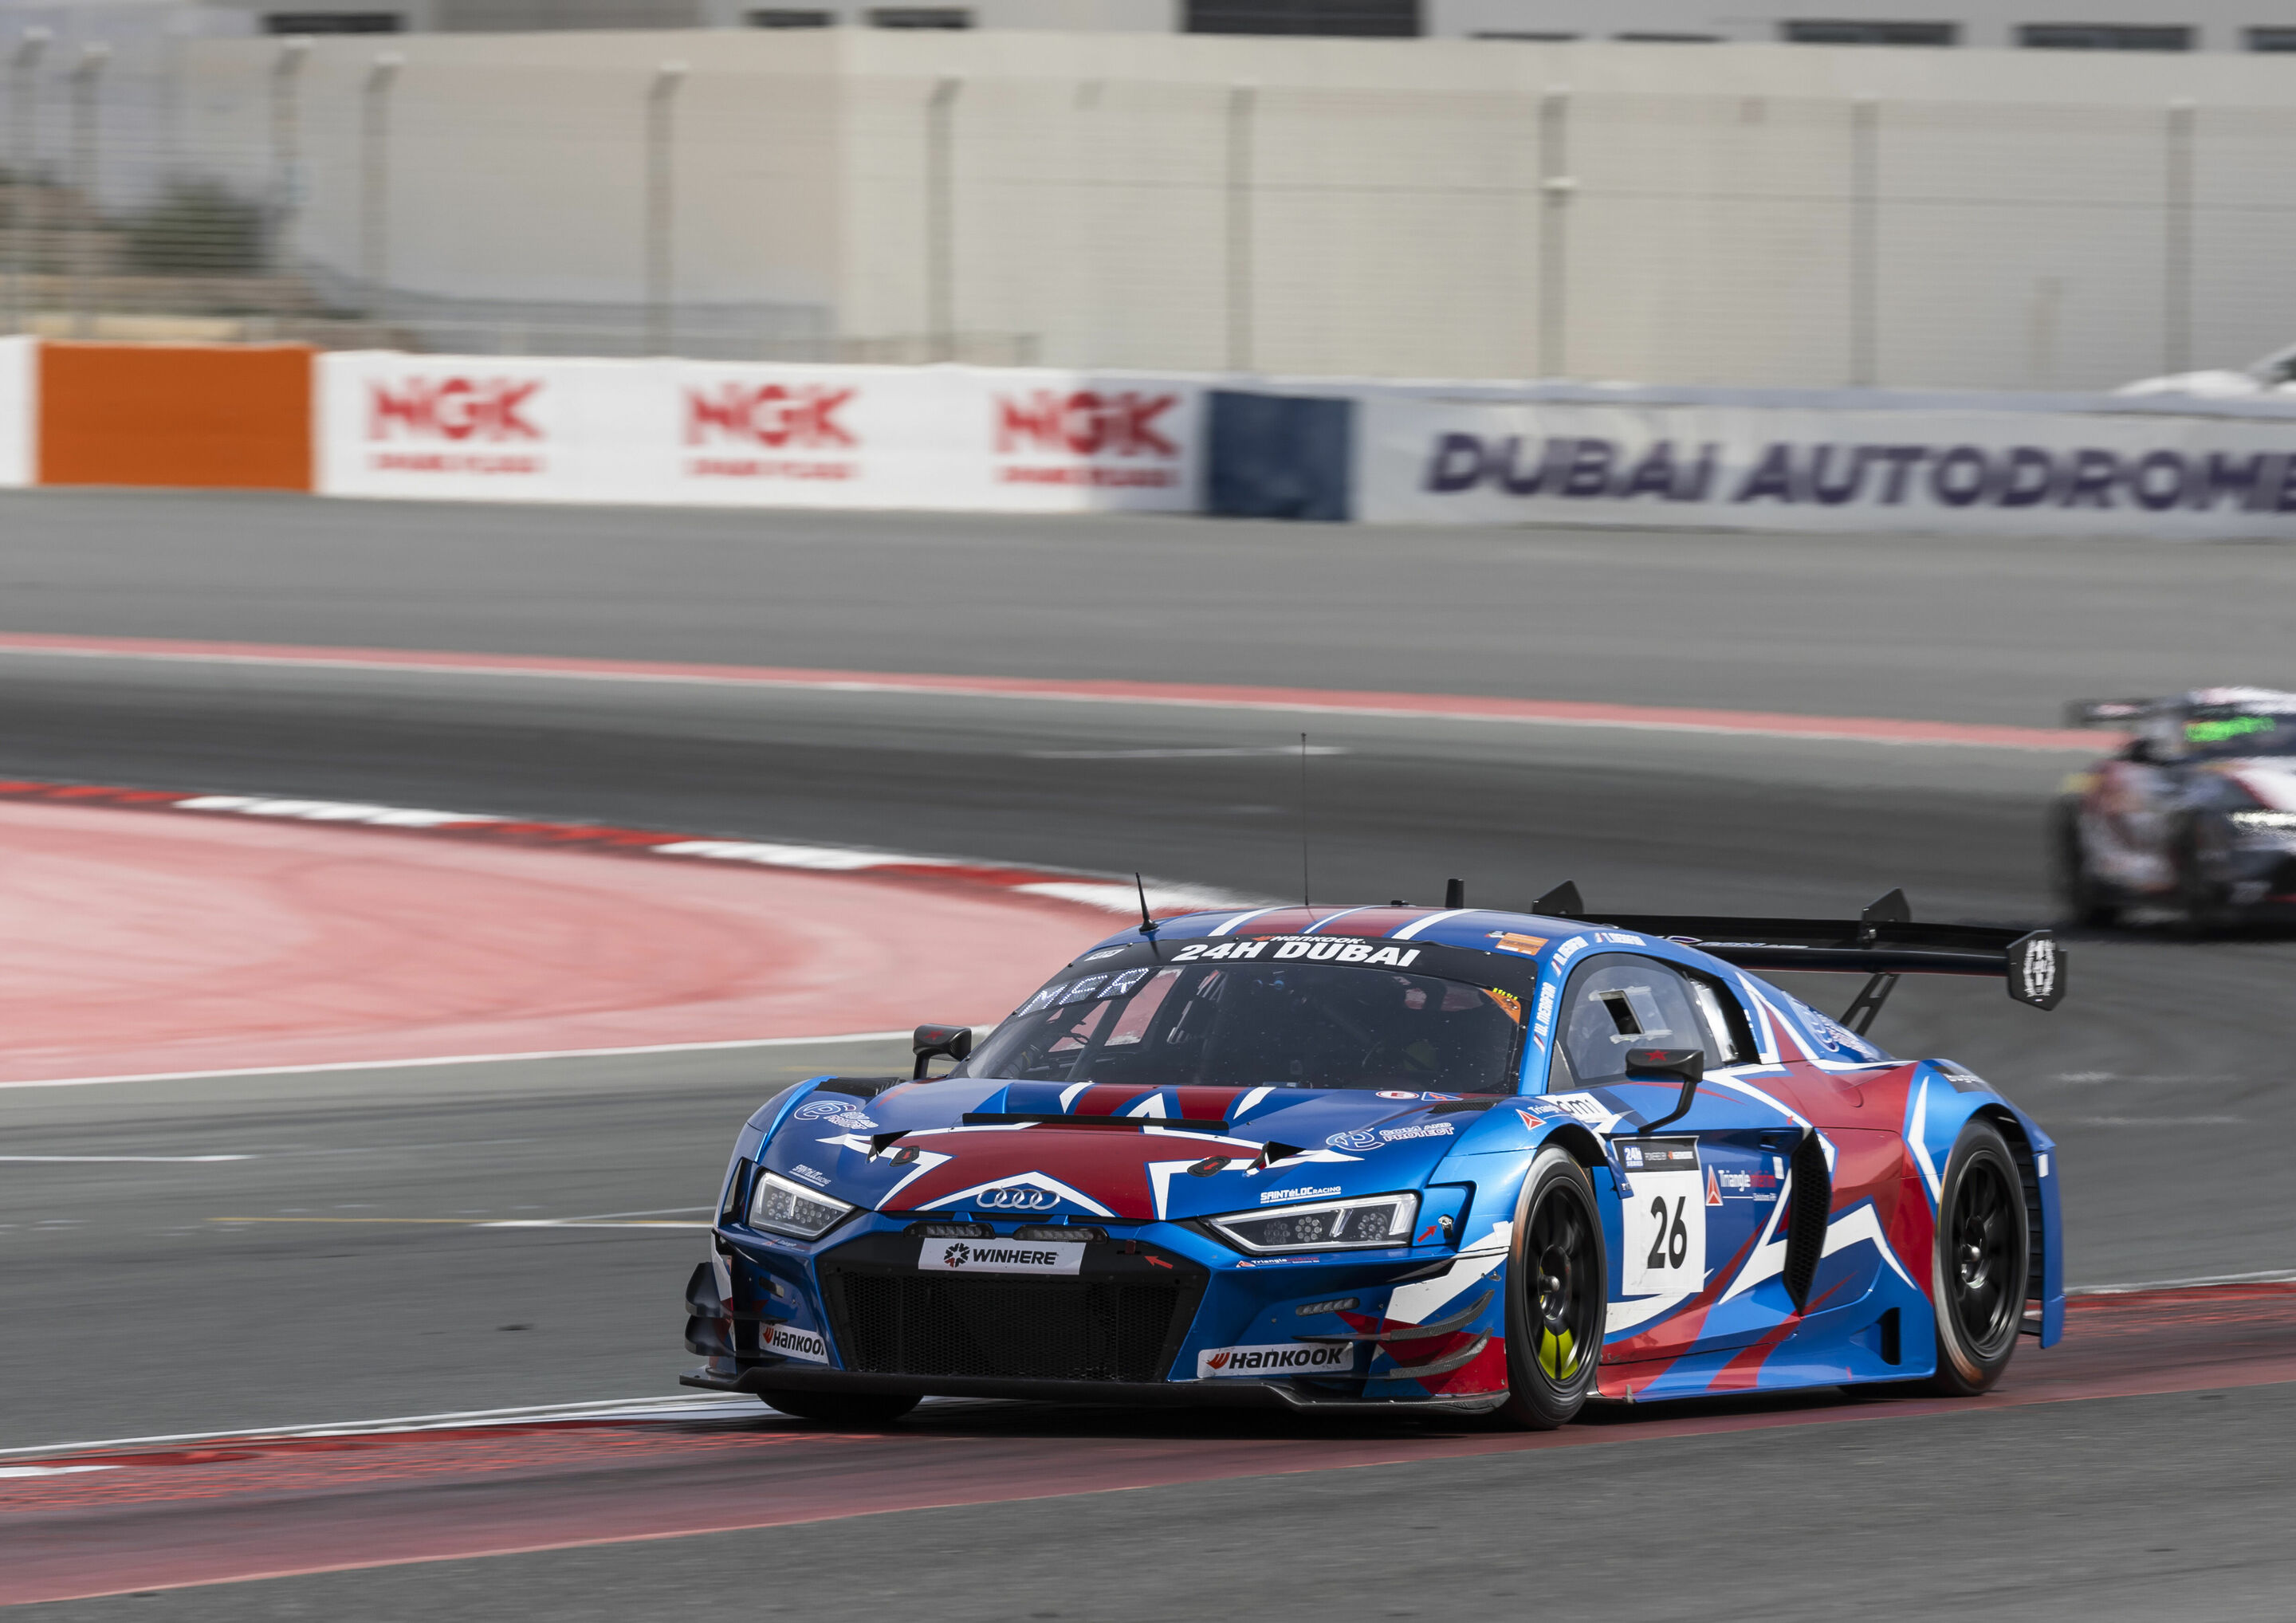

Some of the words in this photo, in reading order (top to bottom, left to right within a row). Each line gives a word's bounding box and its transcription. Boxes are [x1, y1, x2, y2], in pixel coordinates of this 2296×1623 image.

[367, 376, 545, 440] NGK
[684, 384, 859, 446] NGK
[995, 391, 1177, 457] NGK
[1421, 433, 1724, 502] DUBAI
[1171, 941, 1269, 961] 24H
[1273, 941, 1421, 967] DUBAI
[1383, 1127, 1454, 1142] PROTECT
[973, 1248, 1059, 1265] WINHERE
[1647, 1196, 1687, 1269] 26
